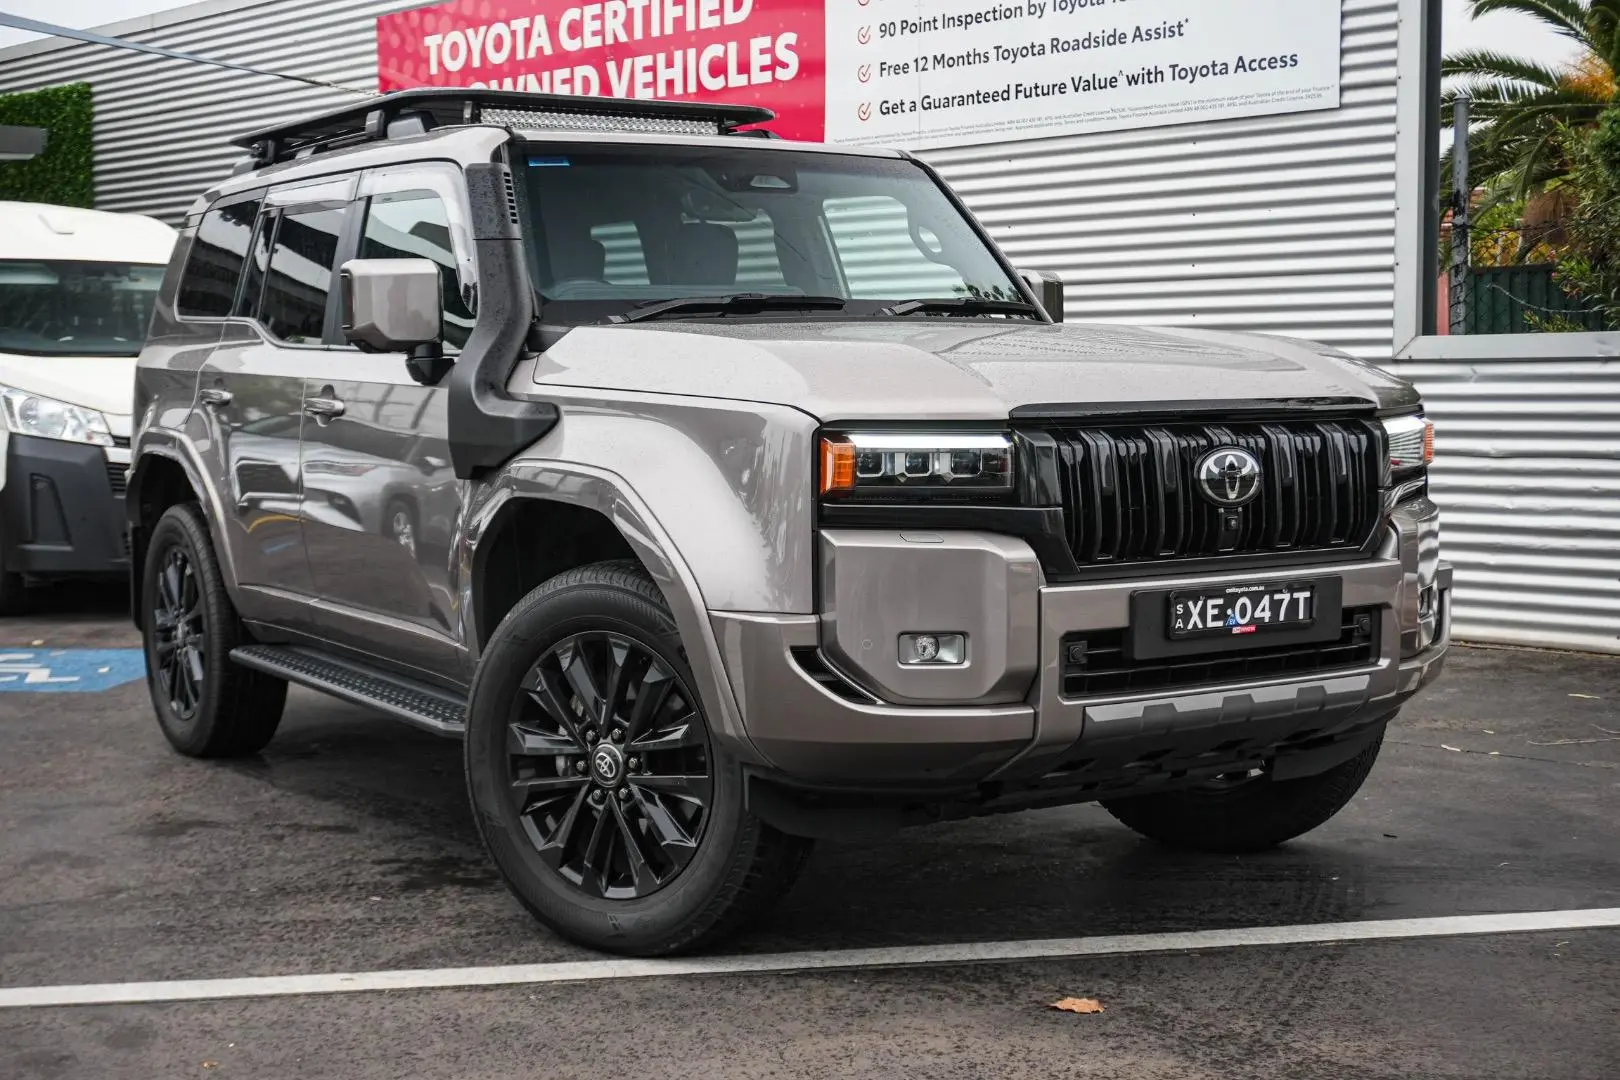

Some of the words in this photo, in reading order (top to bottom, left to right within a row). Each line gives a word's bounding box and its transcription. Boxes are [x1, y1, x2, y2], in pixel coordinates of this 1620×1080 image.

[424, 14, 553, 75] TOYOTA
[558, 0, 752, 51] CERTIFIED
[879, 22, 897, 39] 90
[900, 16, 938, 36] Point
[942, 4, 1023, 31] Inspection
[1027, 0, 1047, 19] by
[606, 32, 800, 100] VEHICLES
[879, 99, 905, 116] Get
[908, 101, 918, 113] a
[921, 84, 1011, 112] Guaranteed
[1014, 80, 1067, 100] Future
[1126, 65, 1164, 87] with
[1169, 60, 1229, 84] Toyota
[1233, 53, 1299, 75] Access
[880, 61, 909, 78] Free
[913, 57, 929, 73] 12
[932, 49, 990, 71] Months
[993, 41, 1046, 63] Toyota
[1050, 29, 1127, 54] Roadside
